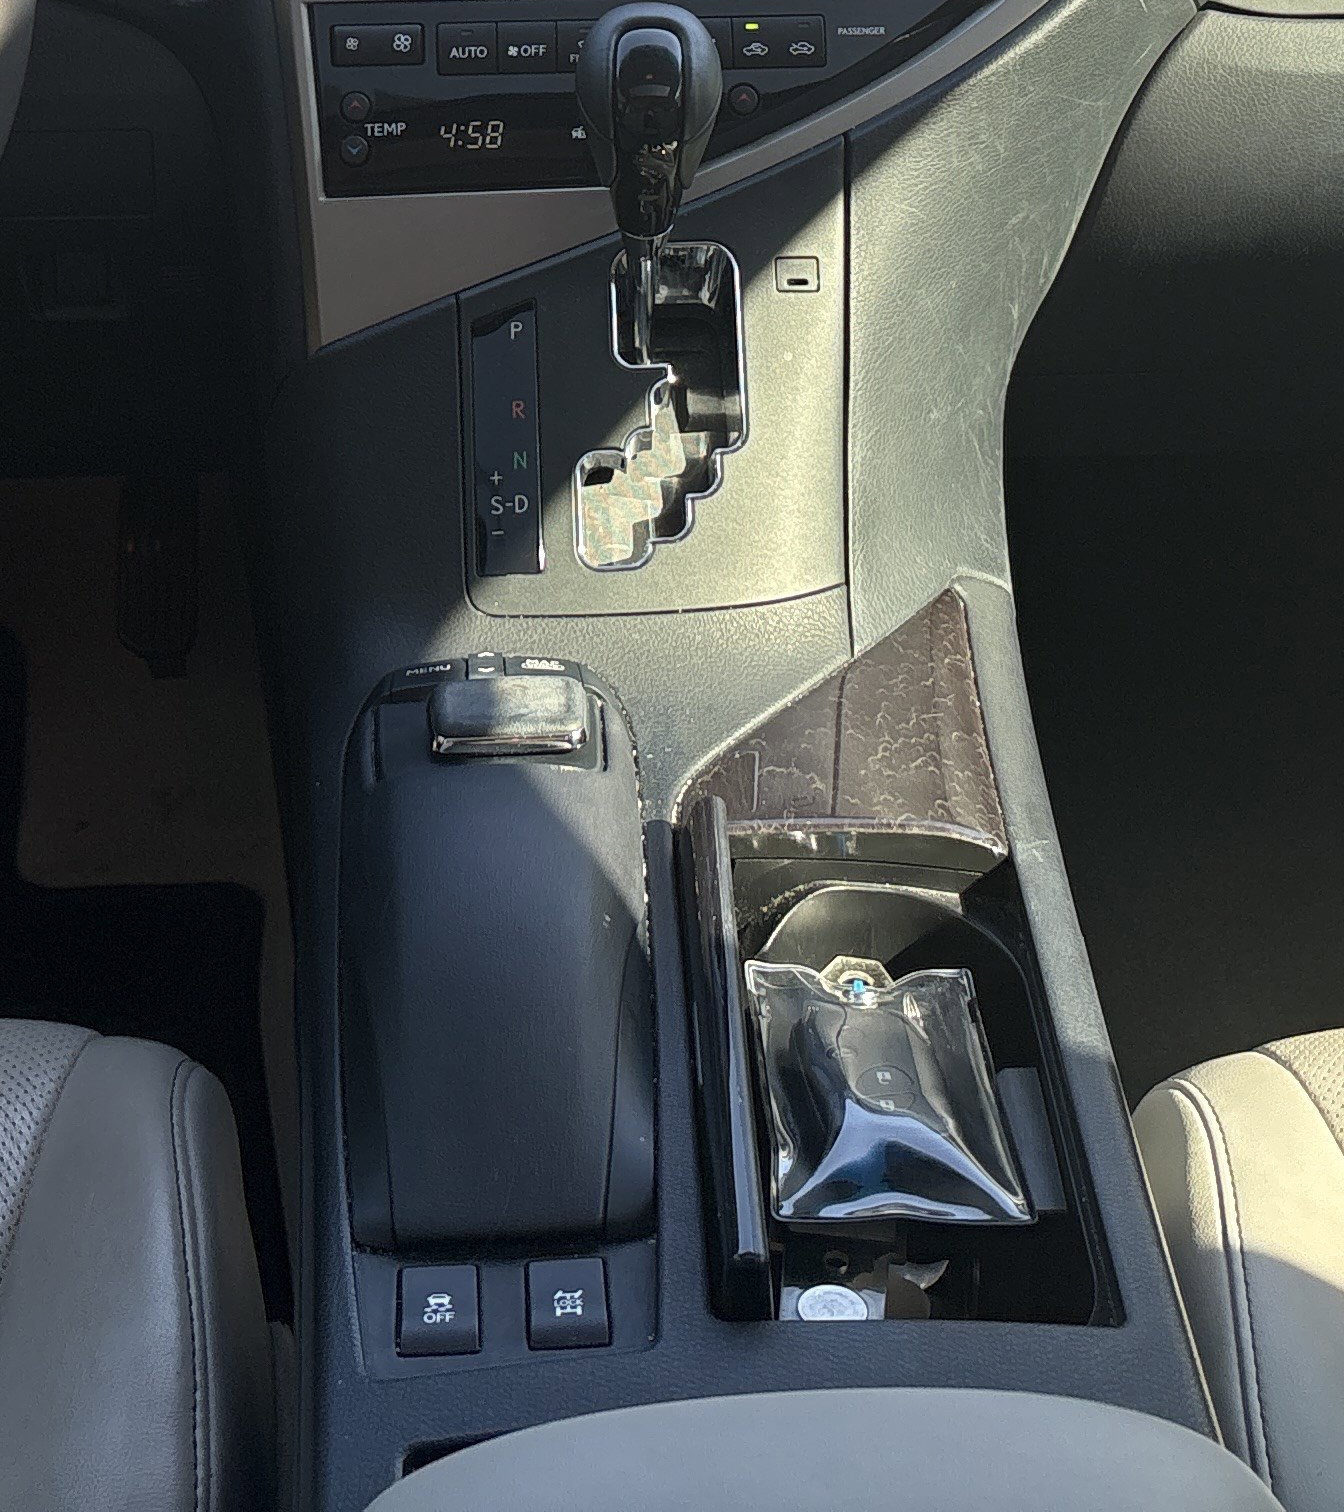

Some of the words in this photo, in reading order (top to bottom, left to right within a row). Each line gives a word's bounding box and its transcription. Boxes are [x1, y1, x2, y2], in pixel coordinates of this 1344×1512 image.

[837, 26, 886, 36] PASSENGER
[449, 46, 487, 59] AUTO
[520, 44, 547, 58] OFF
[364, 122, 406, 137] TEMP
[439, 120, 504, 149] 4:58
[510, 321, 523, 339] P
[511, 400, 526, 419] R
[513, 451, 527, 470] N
[406, 664, 451, 676] MENU
[554, 1298, 584, 1307] LOCK
[423, 1311, 456, 1324] OFF
